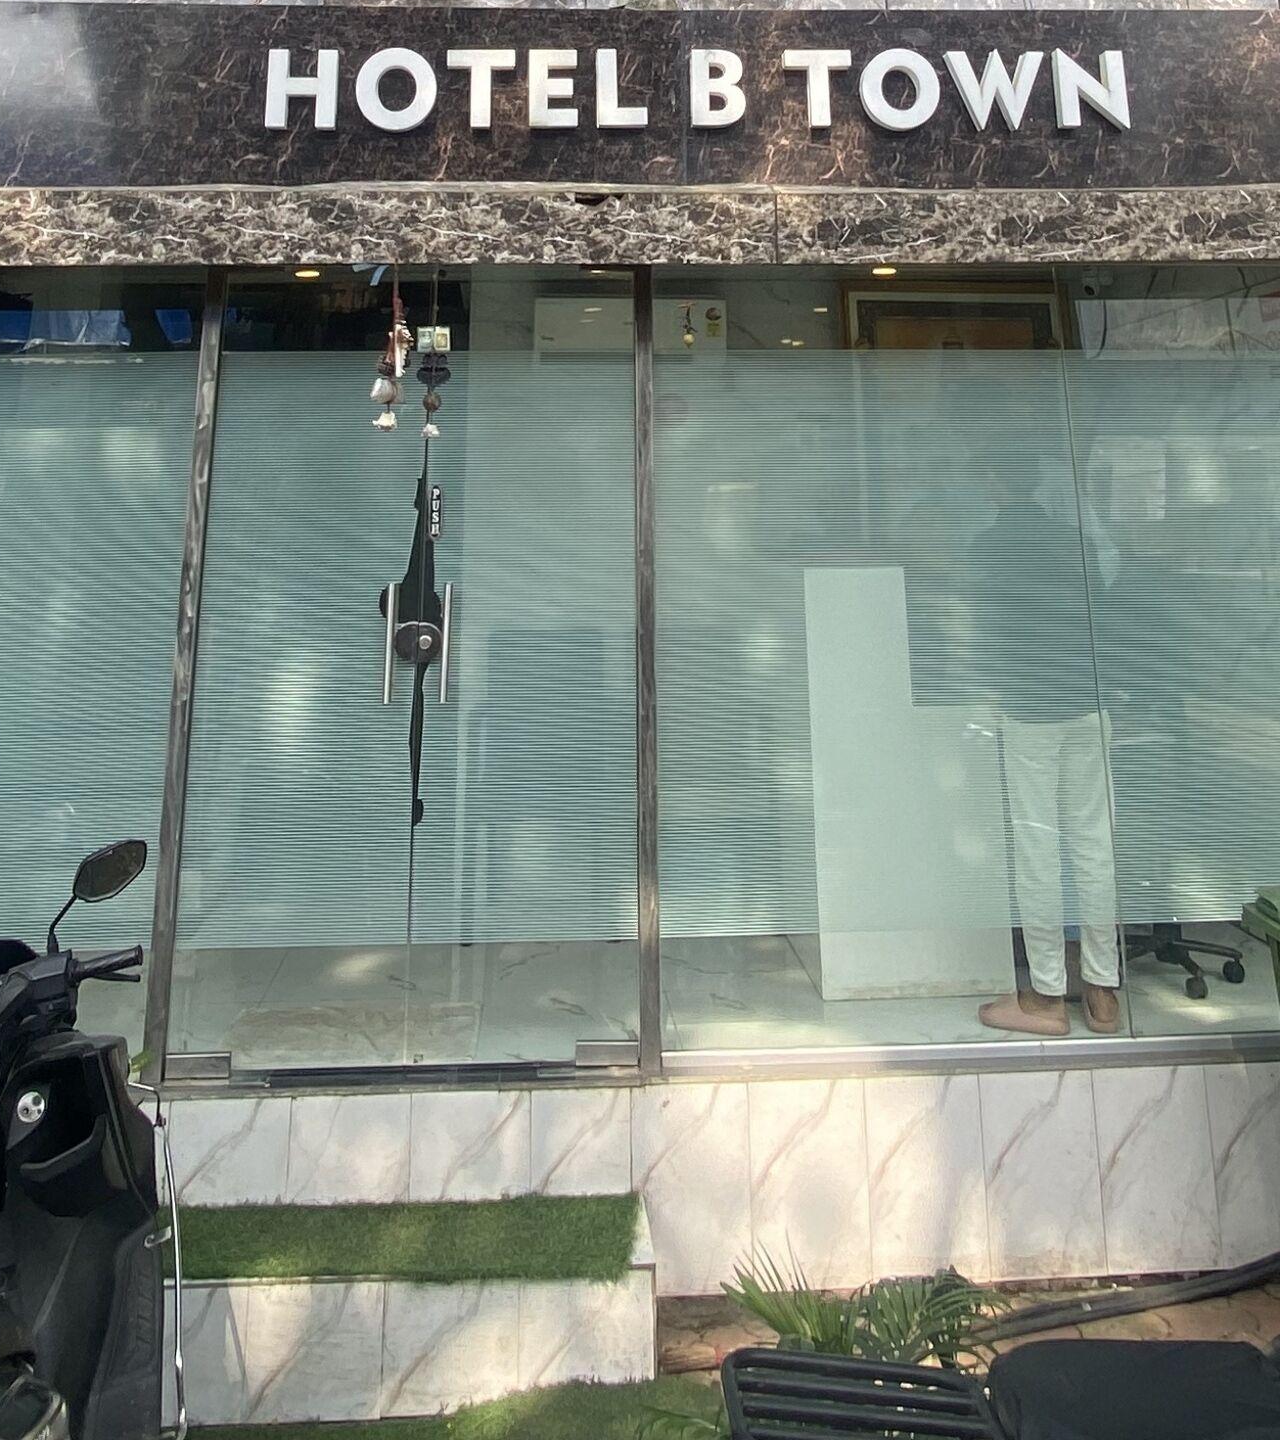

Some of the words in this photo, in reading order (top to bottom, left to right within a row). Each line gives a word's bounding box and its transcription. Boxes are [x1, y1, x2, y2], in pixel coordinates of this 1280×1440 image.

[264, 47, 649, 132] HOTEL
[690, 48, 747, 129] B
[781, 47, 1132, 133] TOWN
[430, 487, 440, 535] PUSH
